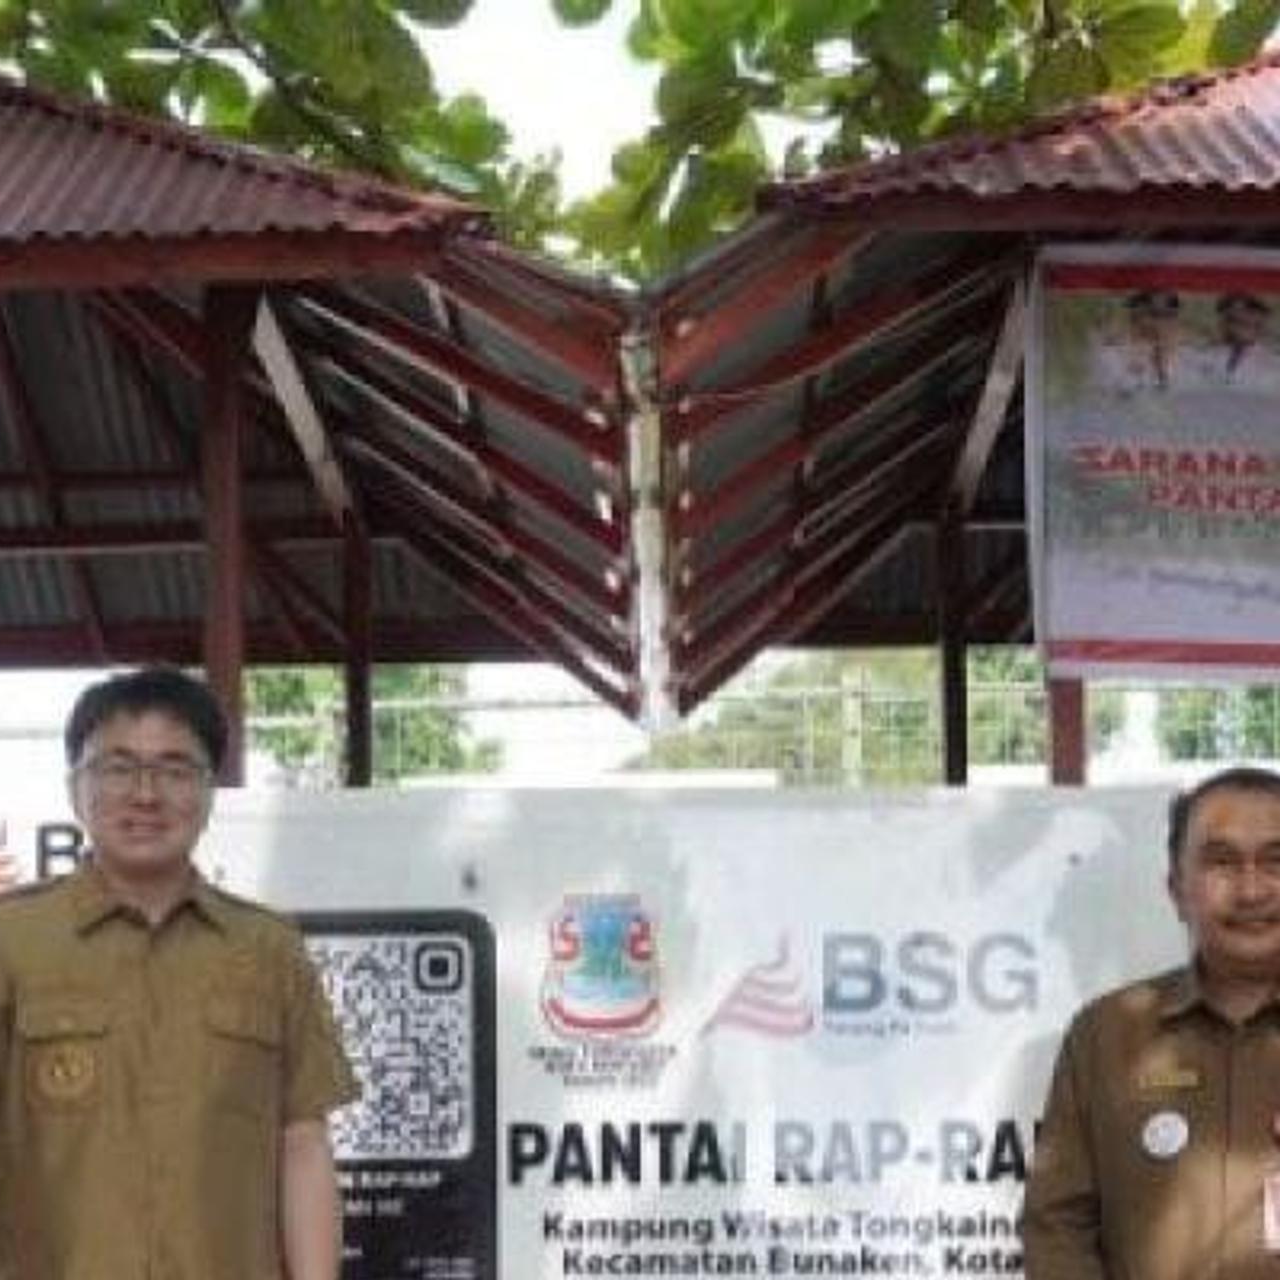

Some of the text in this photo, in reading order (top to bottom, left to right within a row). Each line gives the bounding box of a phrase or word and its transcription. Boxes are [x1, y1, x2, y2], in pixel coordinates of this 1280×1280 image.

[1074, 444, 1267, 479] SARANA
[821, 930, 1040, 1014] BSG
[505, 1119, 1042, 1185] PANTAI RAP-RA
[543, 1211, 714, 1246] Kampung
[721, 1210, 840, 1240] Wisata
[563, 1248, 756, 1277] Kecamatan
[944, 1248, 1024, 1276] Kota
